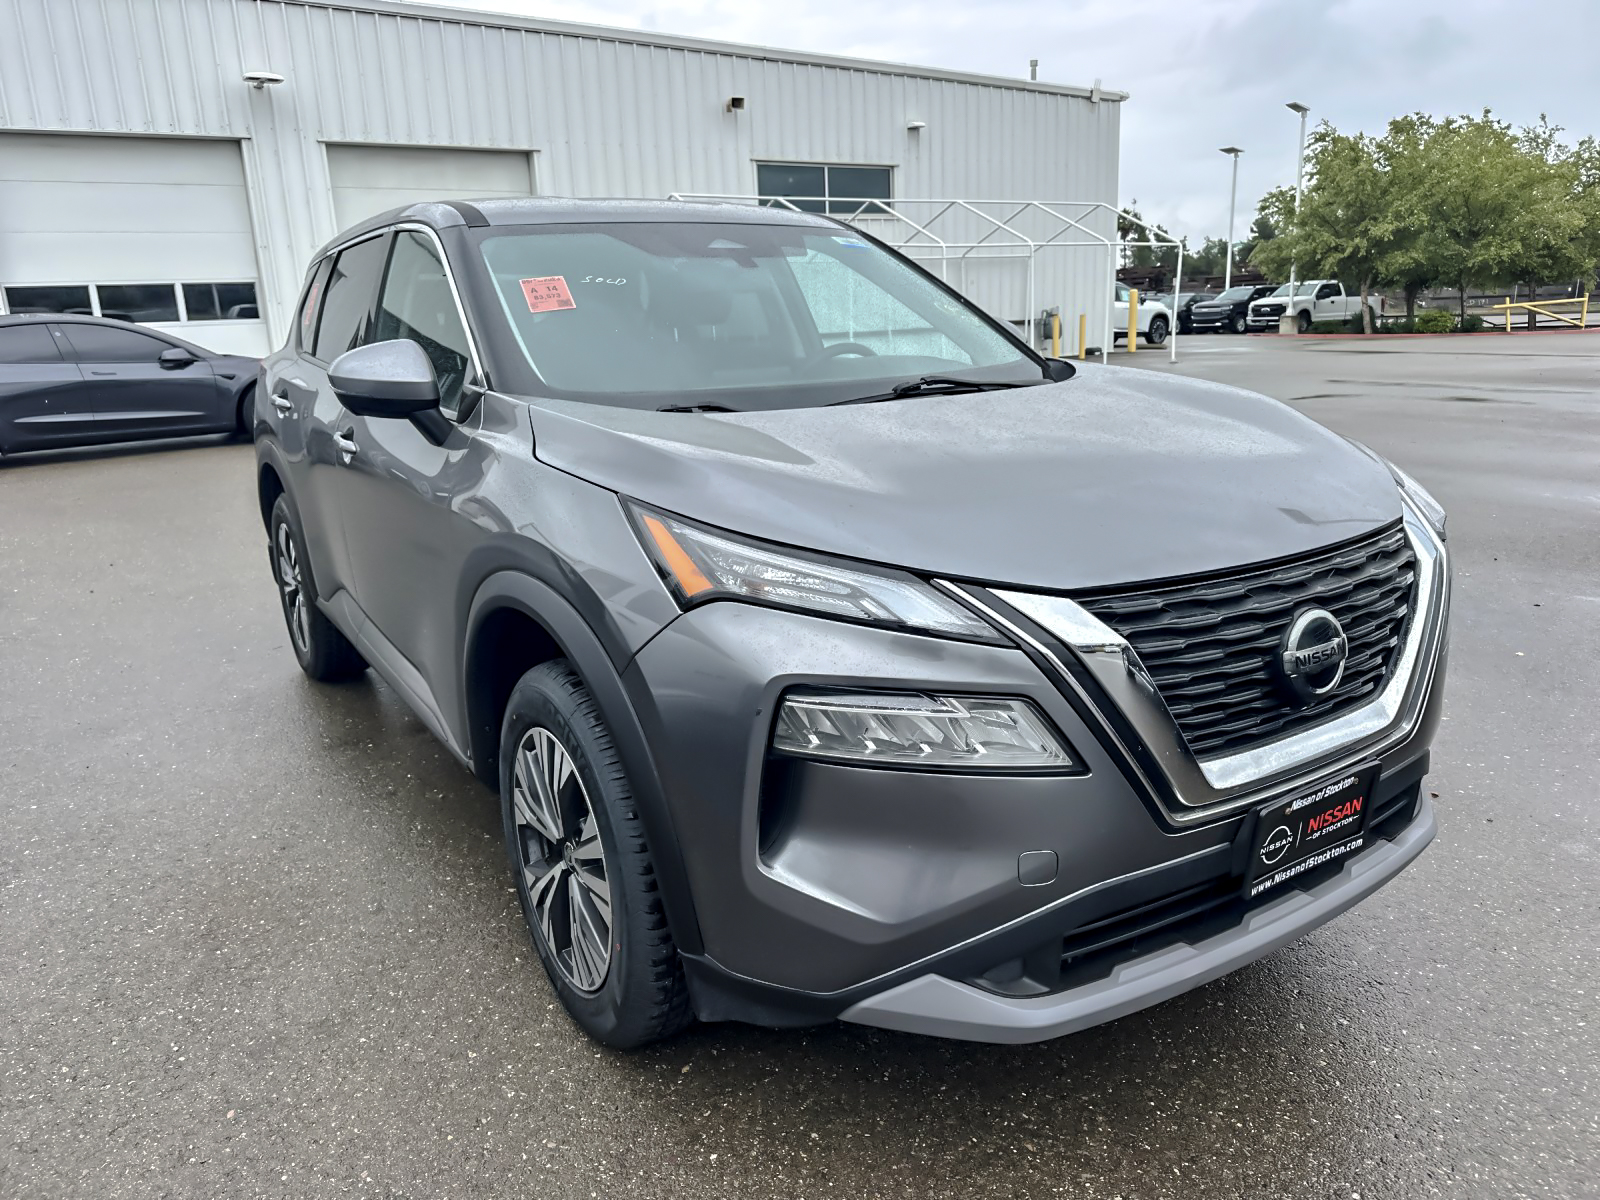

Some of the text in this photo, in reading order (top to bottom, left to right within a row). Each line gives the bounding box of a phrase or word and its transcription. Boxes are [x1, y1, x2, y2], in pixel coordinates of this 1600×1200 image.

[1295, 643, 1343, 669] NISSAN
[1290, 777, 1355, 811] Nissan of Stockton
[1307, 796, 1363, 833] NISSAN
[1312, 817, 1353, 839] OF STOCKTON
[1260, 835, 1293, 855] NISSAN
[1251, 839, 1363, 896] www.NissanofStockton.com
